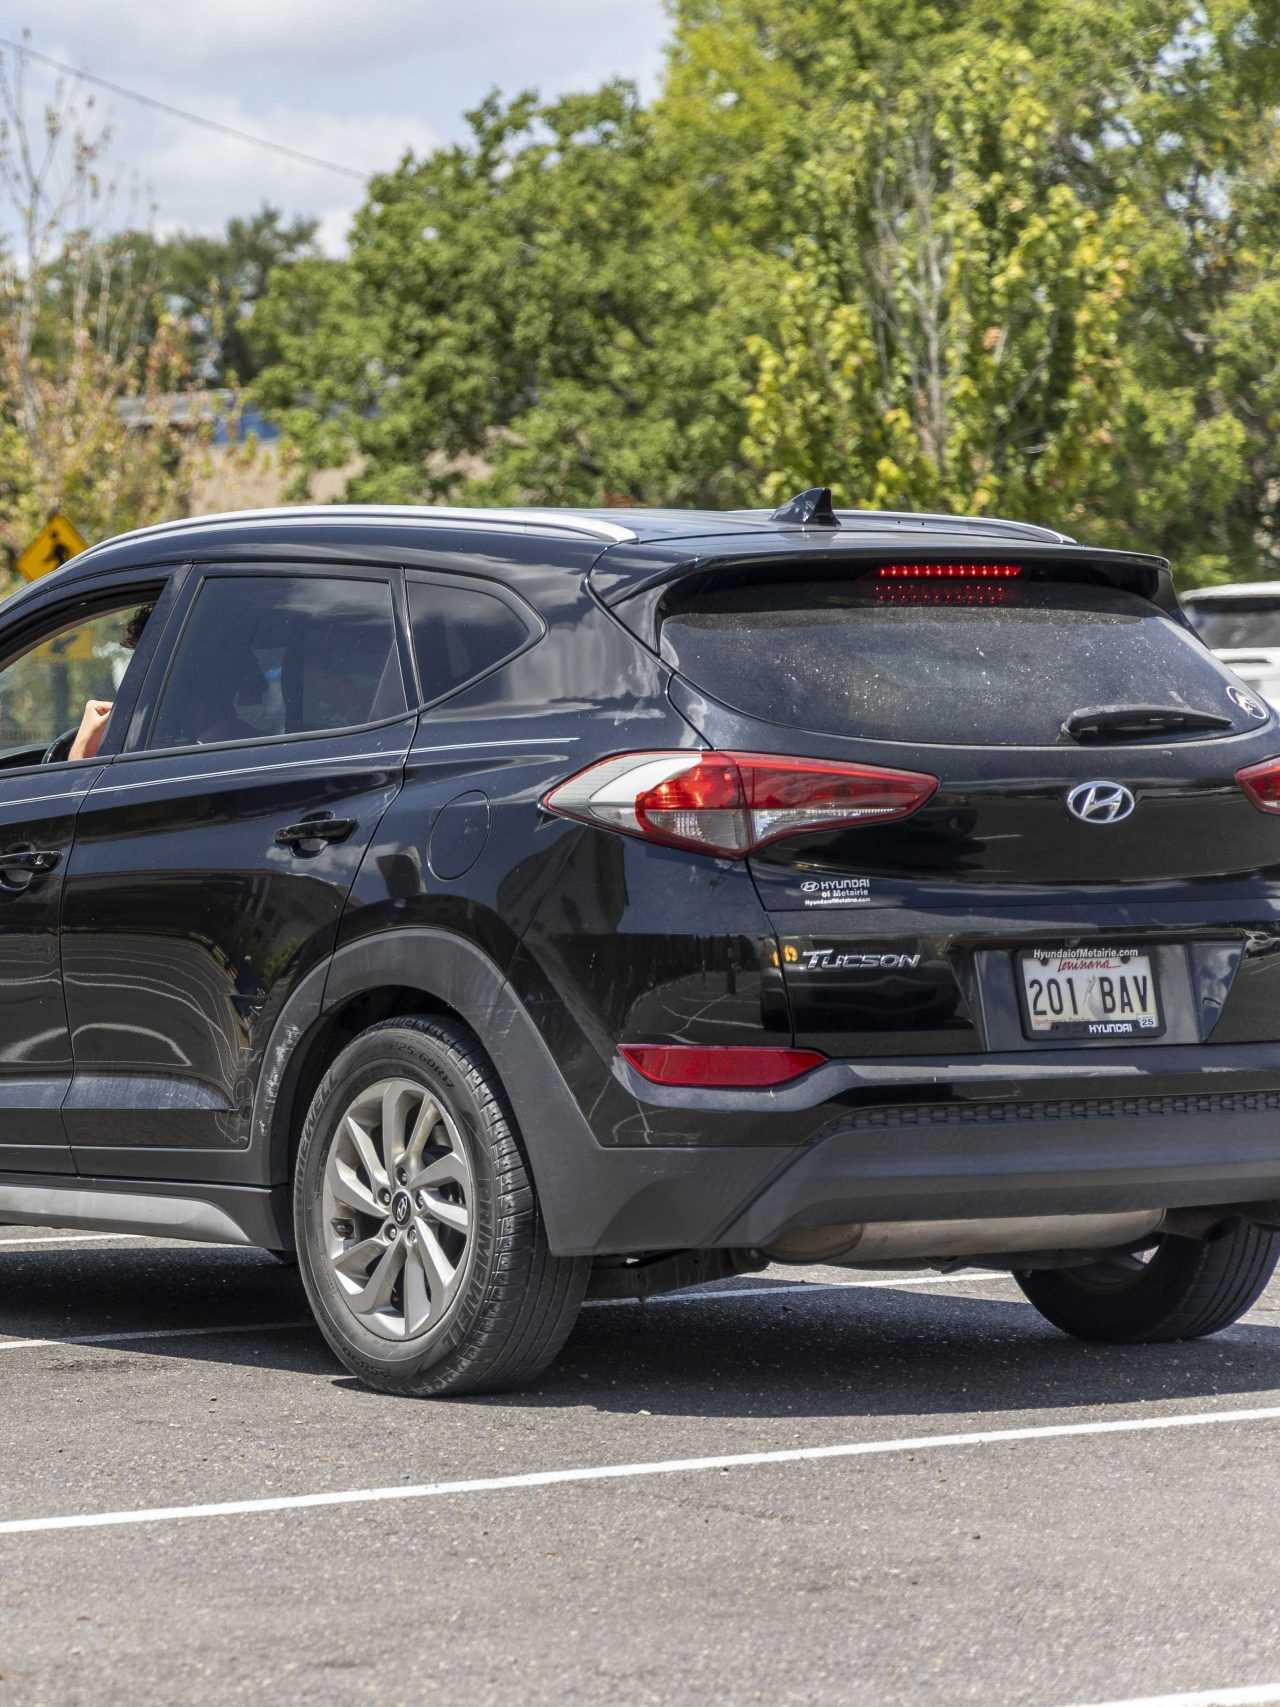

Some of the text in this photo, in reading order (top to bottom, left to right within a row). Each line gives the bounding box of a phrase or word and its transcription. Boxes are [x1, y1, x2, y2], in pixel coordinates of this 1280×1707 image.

[820, 879, 870, 890] HYUNDAI
[821, 888, 869, 898] of Metairie
[1033, 947, 1138, 960] HyundaiofMetairie.com
[1057, 958, 1120, 973] Louisiana
[1029, 975, 1148, 1016] 201 BAV
[1141, 1018, 1154, 1026] 25
[1088, 1023, 1132, 1033] HYUNDAI
